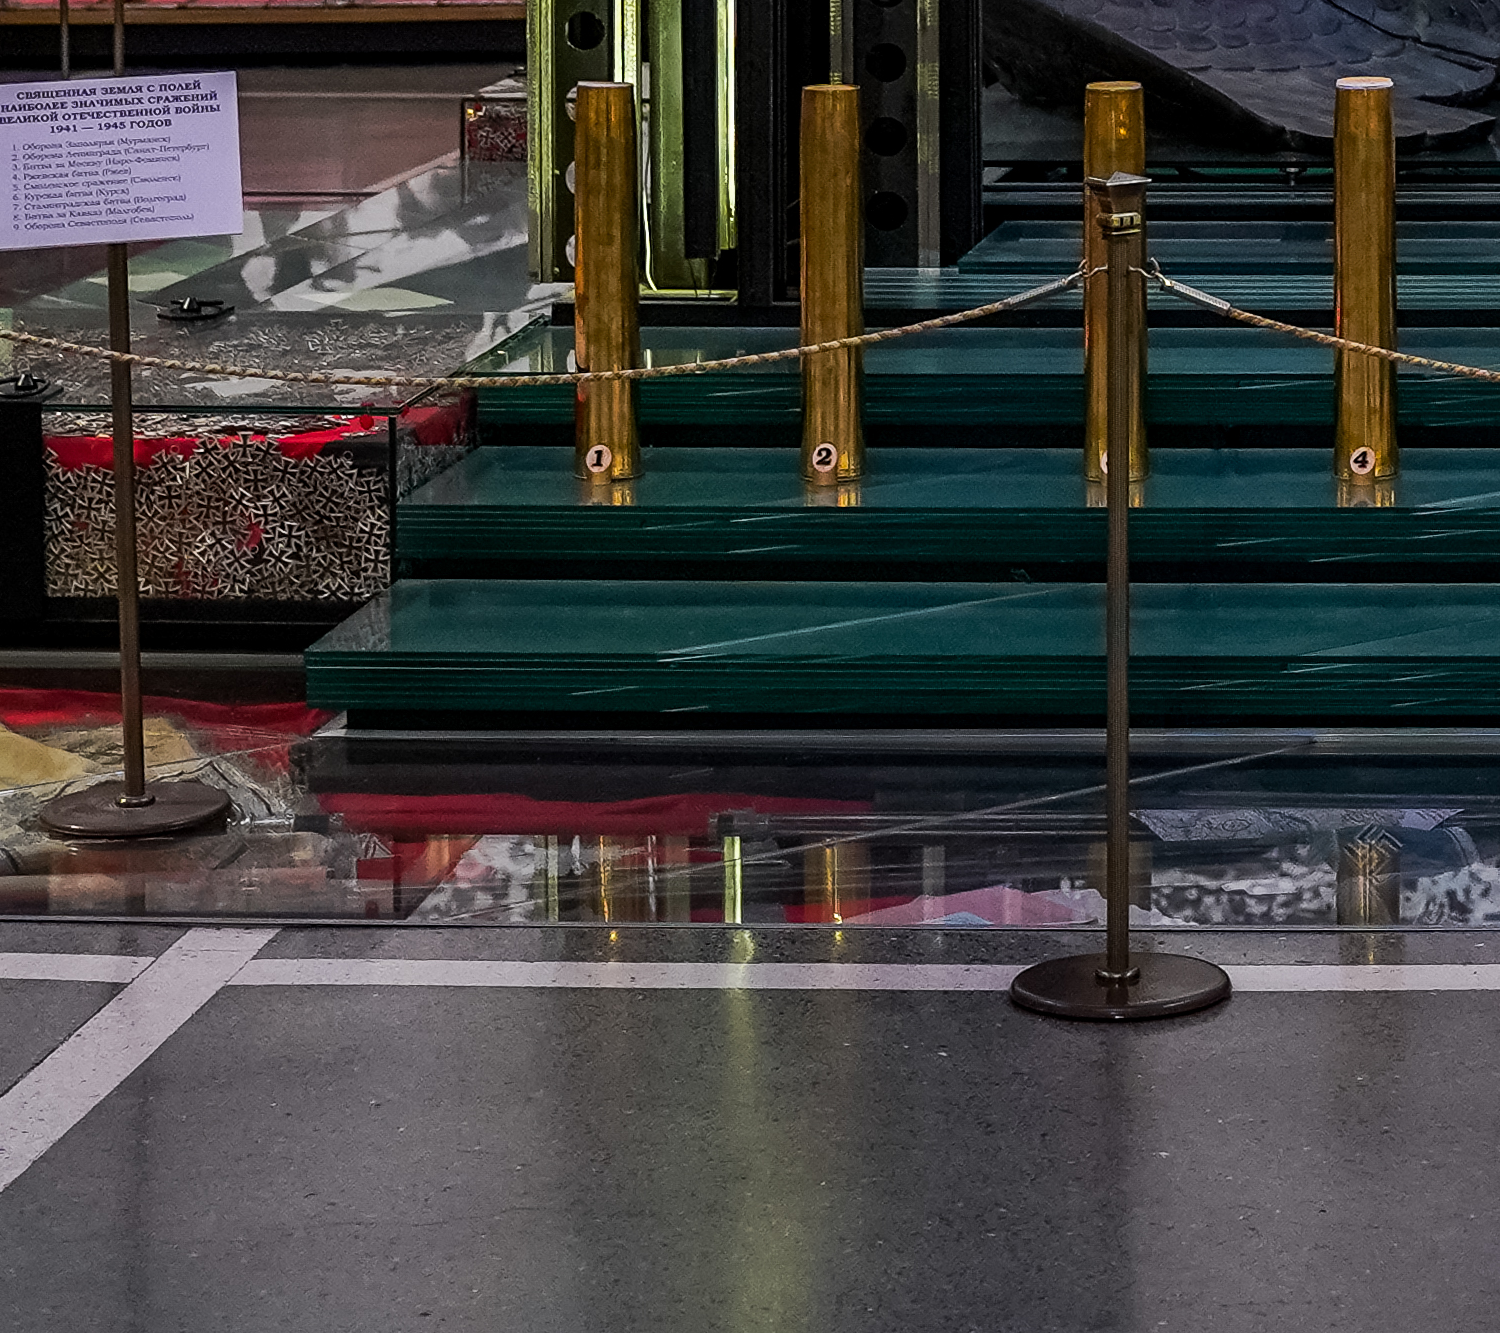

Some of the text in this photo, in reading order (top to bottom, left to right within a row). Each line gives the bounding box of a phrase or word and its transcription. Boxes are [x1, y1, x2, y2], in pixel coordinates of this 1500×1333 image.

[16, 79, 201, 101] СВЯЩЕННАЯ ЗЕМЛЯ С ПОЛЕЙ
[0, 90, 218, 113] НАИБОЛЕЕ ЗНАЧИМЫХ СРАЖЕНИЙ
[62, 106, 171, 121] ОТЕЧЕСТВЕННОЙ
[174, 102, 222, 115] ВОЙНЫ
[49, 124, 78, 134] 1941
[97, 122, 127, 132] 1945
[130, 118, 173, 130] ГОДОВ
